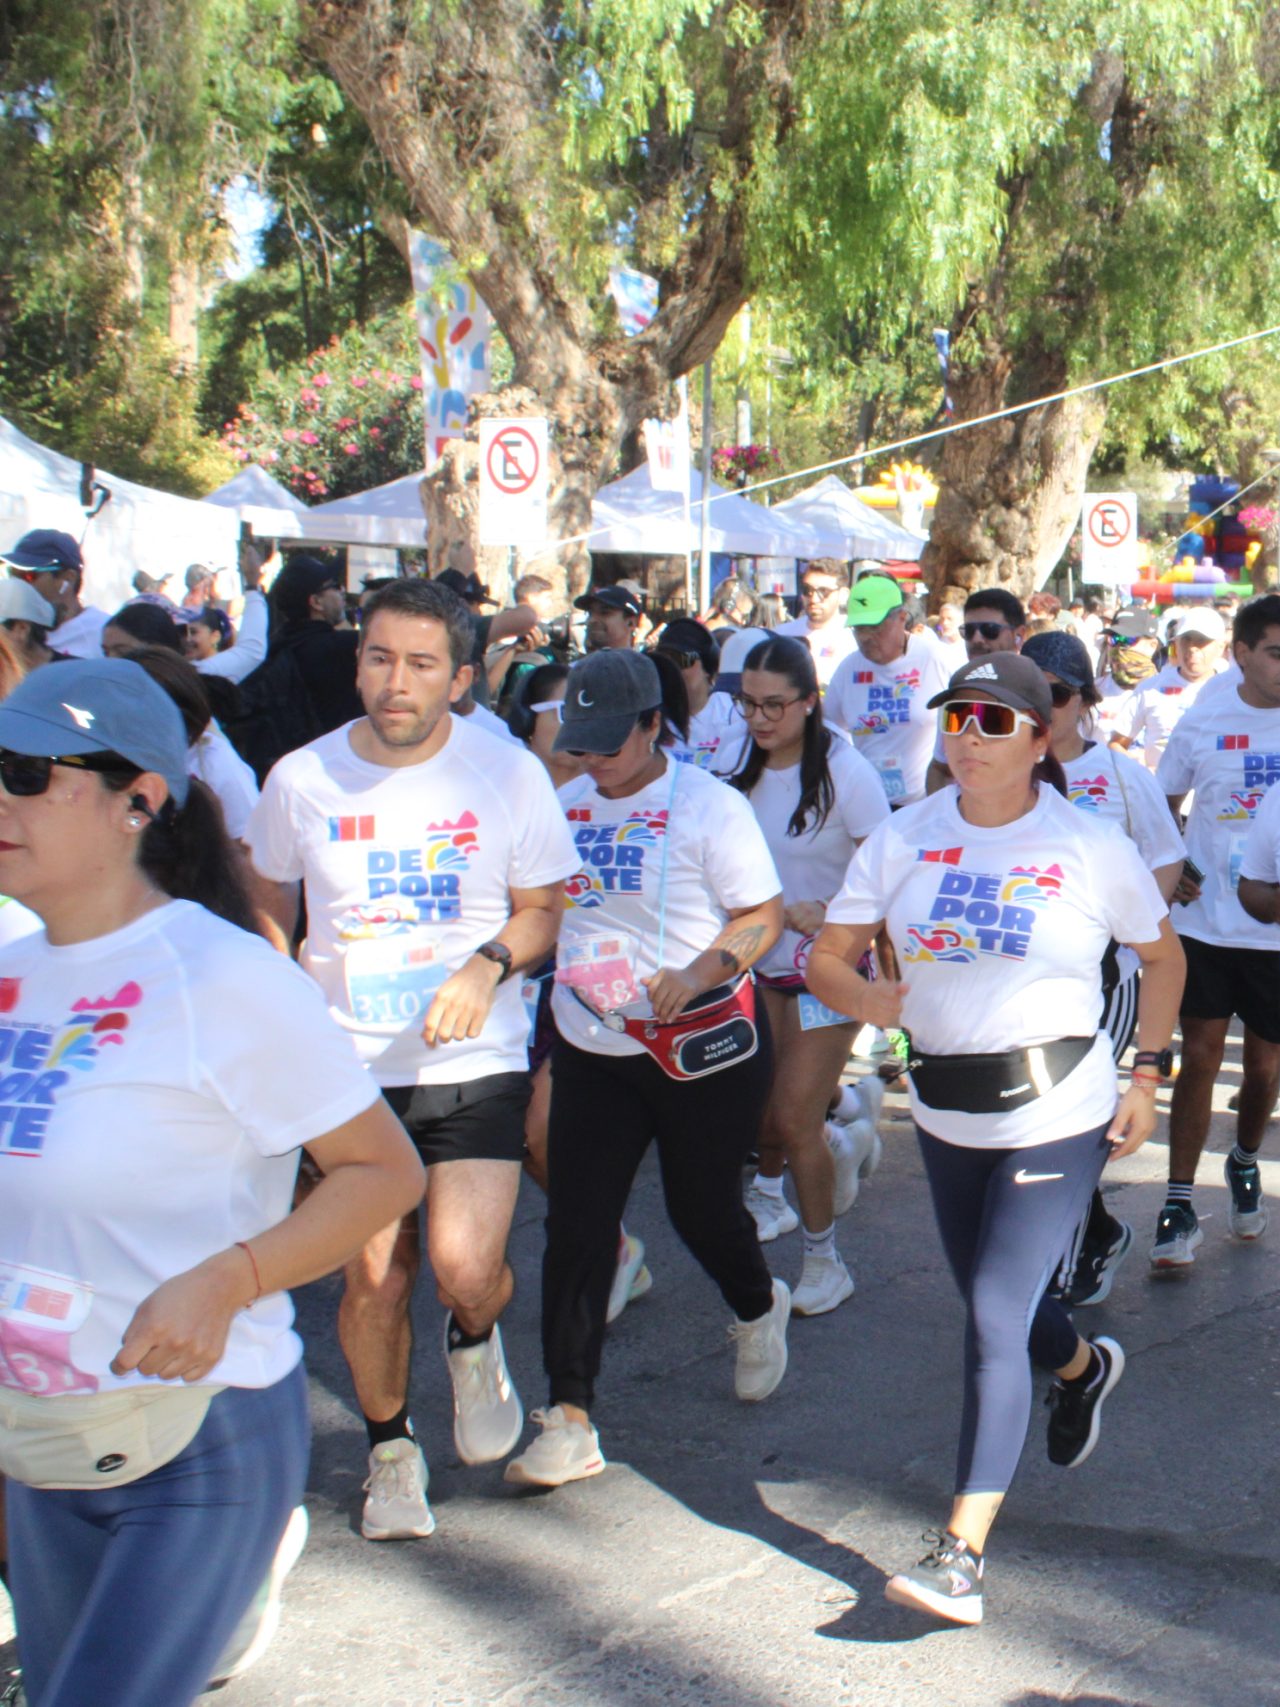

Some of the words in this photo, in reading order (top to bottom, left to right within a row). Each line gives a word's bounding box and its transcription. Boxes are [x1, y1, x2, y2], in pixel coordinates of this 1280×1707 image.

[868, 699, 910, 712] POR
[869, 687, 893, 699] DE
[887, 711, 910, 723] TE
[574, 826, 619, 845] DE
[367, 849, 423, 875] DE
[367, 874, 461, 900] POR
[600, 867, 643, 892] TE
[938, 872, 1002, 901] DE
[413, 898, 462, 921] TE
[929, 896, 1037, 934] POR
[975, 928, 1032, 957] TE
[704, 1035, 733, 1052] TOMMY
[0, 1069, 71, 1105] OR
